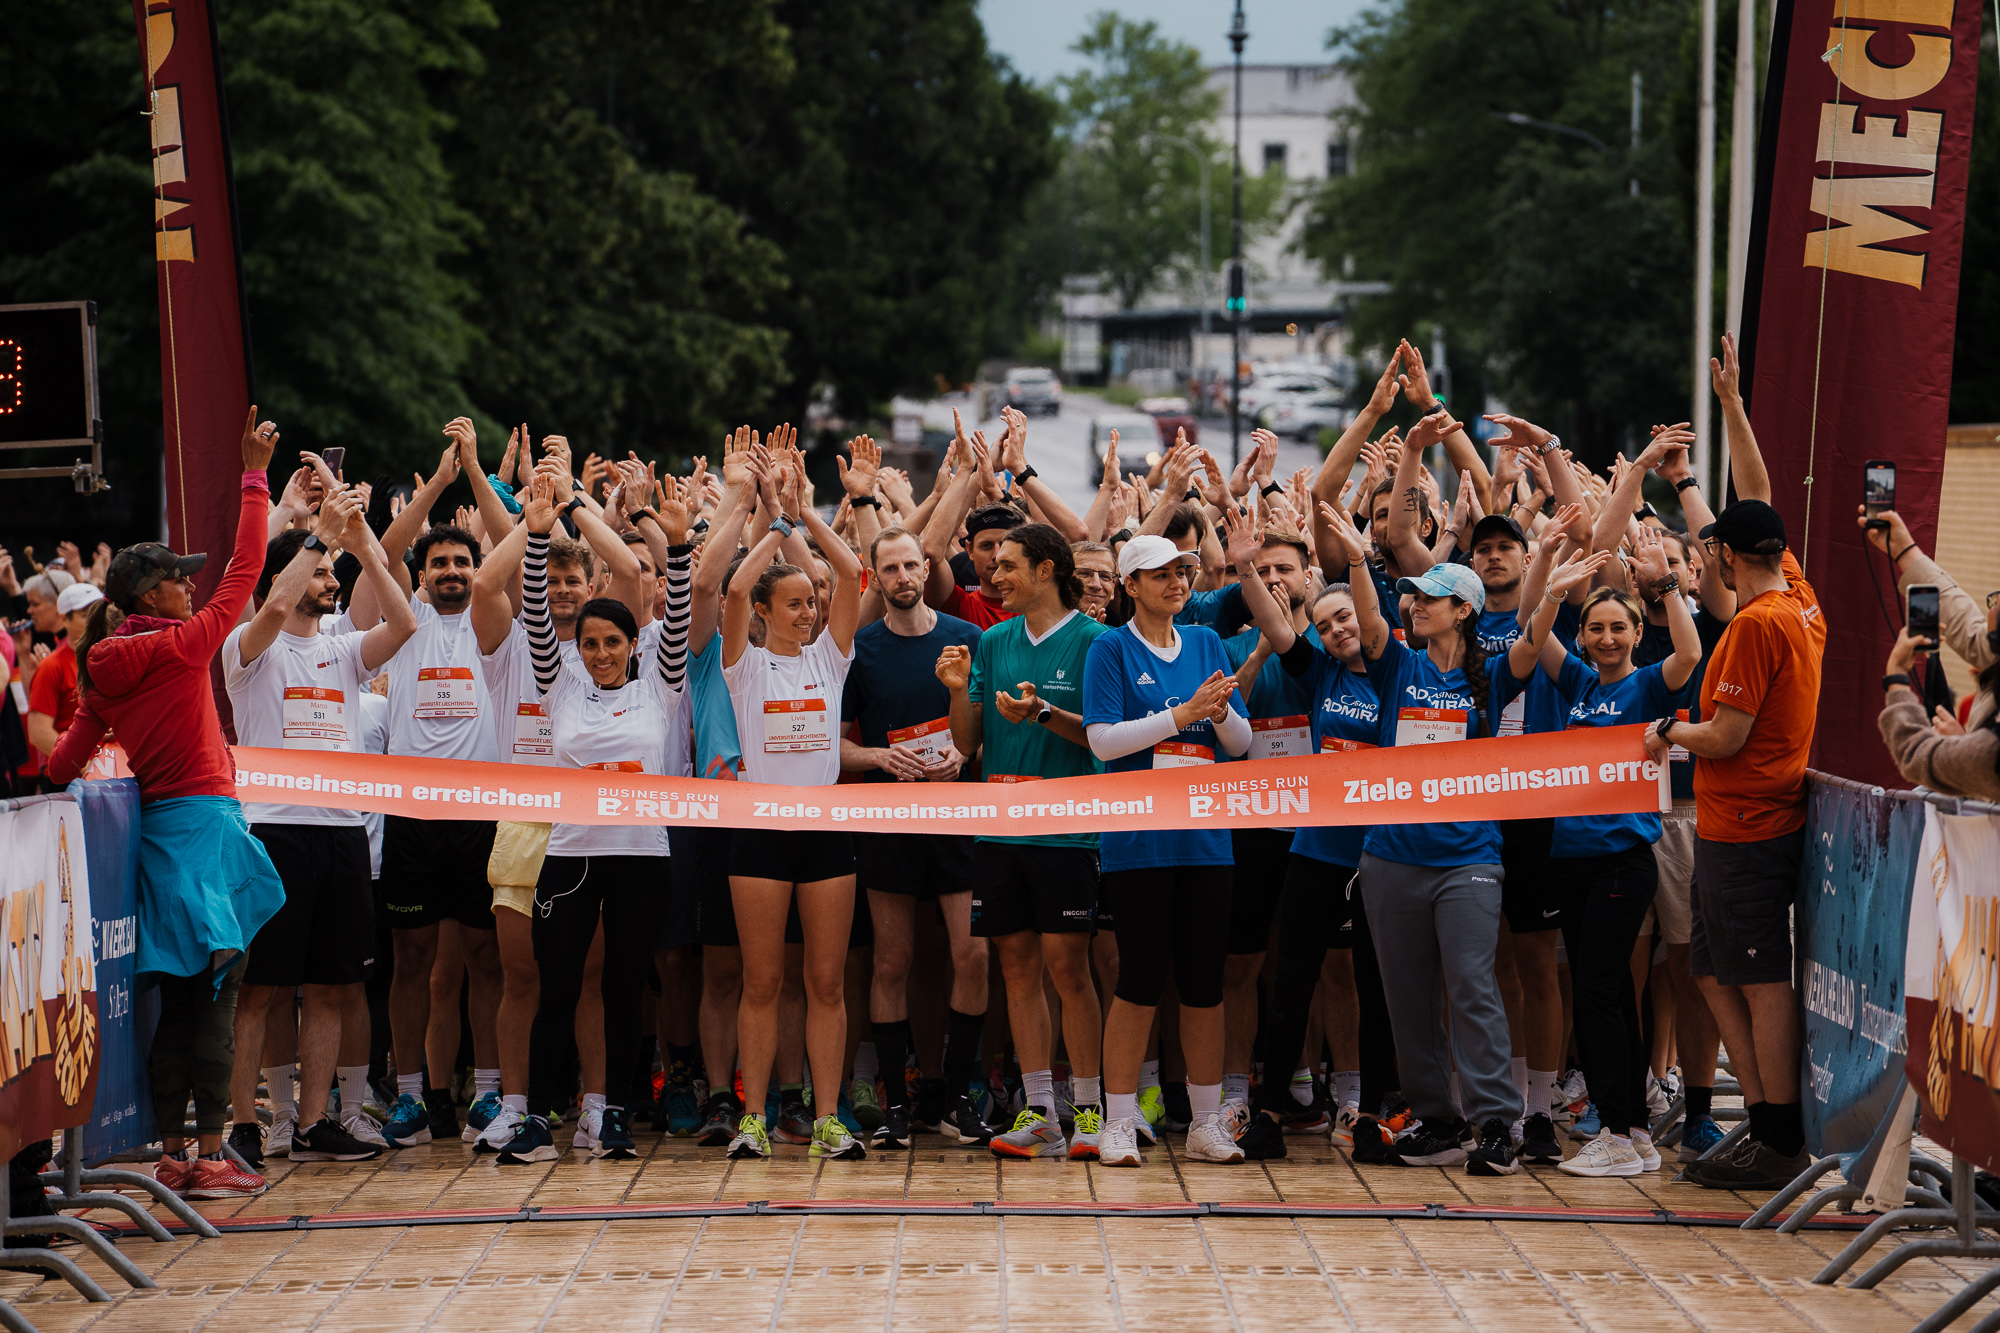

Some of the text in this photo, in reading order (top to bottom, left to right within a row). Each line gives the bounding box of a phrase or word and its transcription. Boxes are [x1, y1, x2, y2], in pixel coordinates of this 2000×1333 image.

[1803, 0, 1955, 291] MEC
[1717, 681, 1742, 696] 2017
[313, 711, 325, 719] 531
[792, 724, 805, 732] 527
[1413, 723, 1451, 731] Anna-Maria
[917, 738, 932, 746] Felix
[1262, 731, 1292, 739] Fernando
[1271, 741, 1284, 749] 591
[235, 769, 562, 808] gemeinsam erreichen!
[1188, 775, 1309, 795] BUSINESS RUN
[1343, 777, 1413, 804] Ziele
[1421, 765, 1590, 803] gemeinsam
[598, 787, 719, 802] BUSINESS RUN
[753, 795, 1154, 821] Ziele gemeinsam erreichen!
